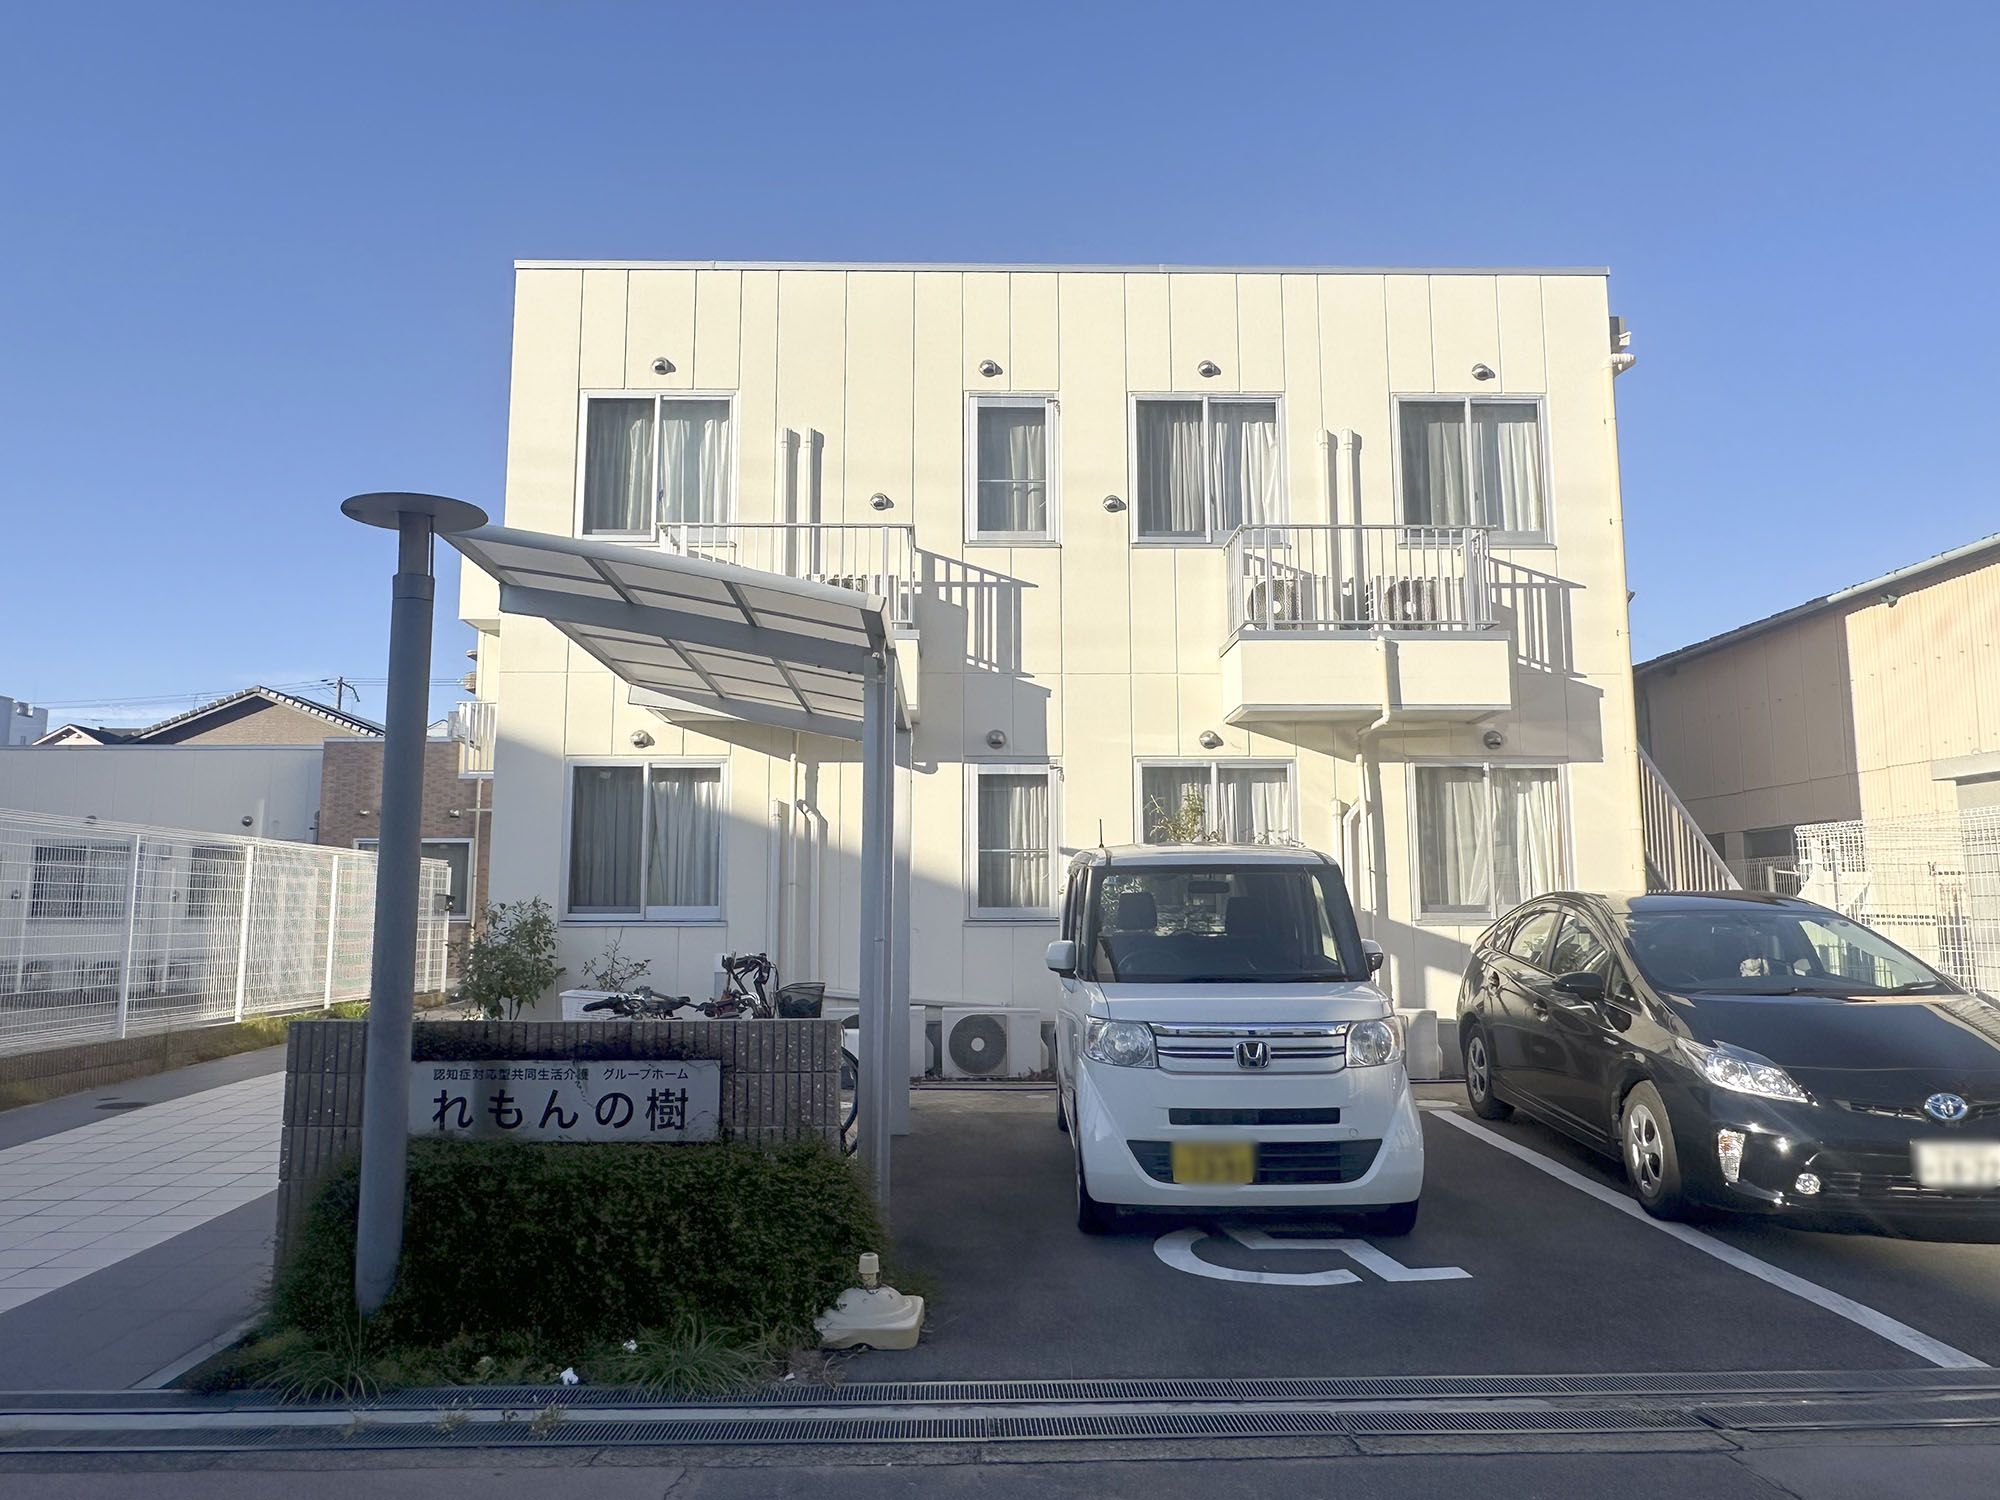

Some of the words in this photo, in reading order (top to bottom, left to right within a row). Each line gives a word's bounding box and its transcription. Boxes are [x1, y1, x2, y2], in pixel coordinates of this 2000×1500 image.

[433, 1068, 589, 1081] 認知症対応型共同生活介護
[603, 1068, 689, 1080] グループホーム
[432, 1087, 689, 1131] れもんの樹
